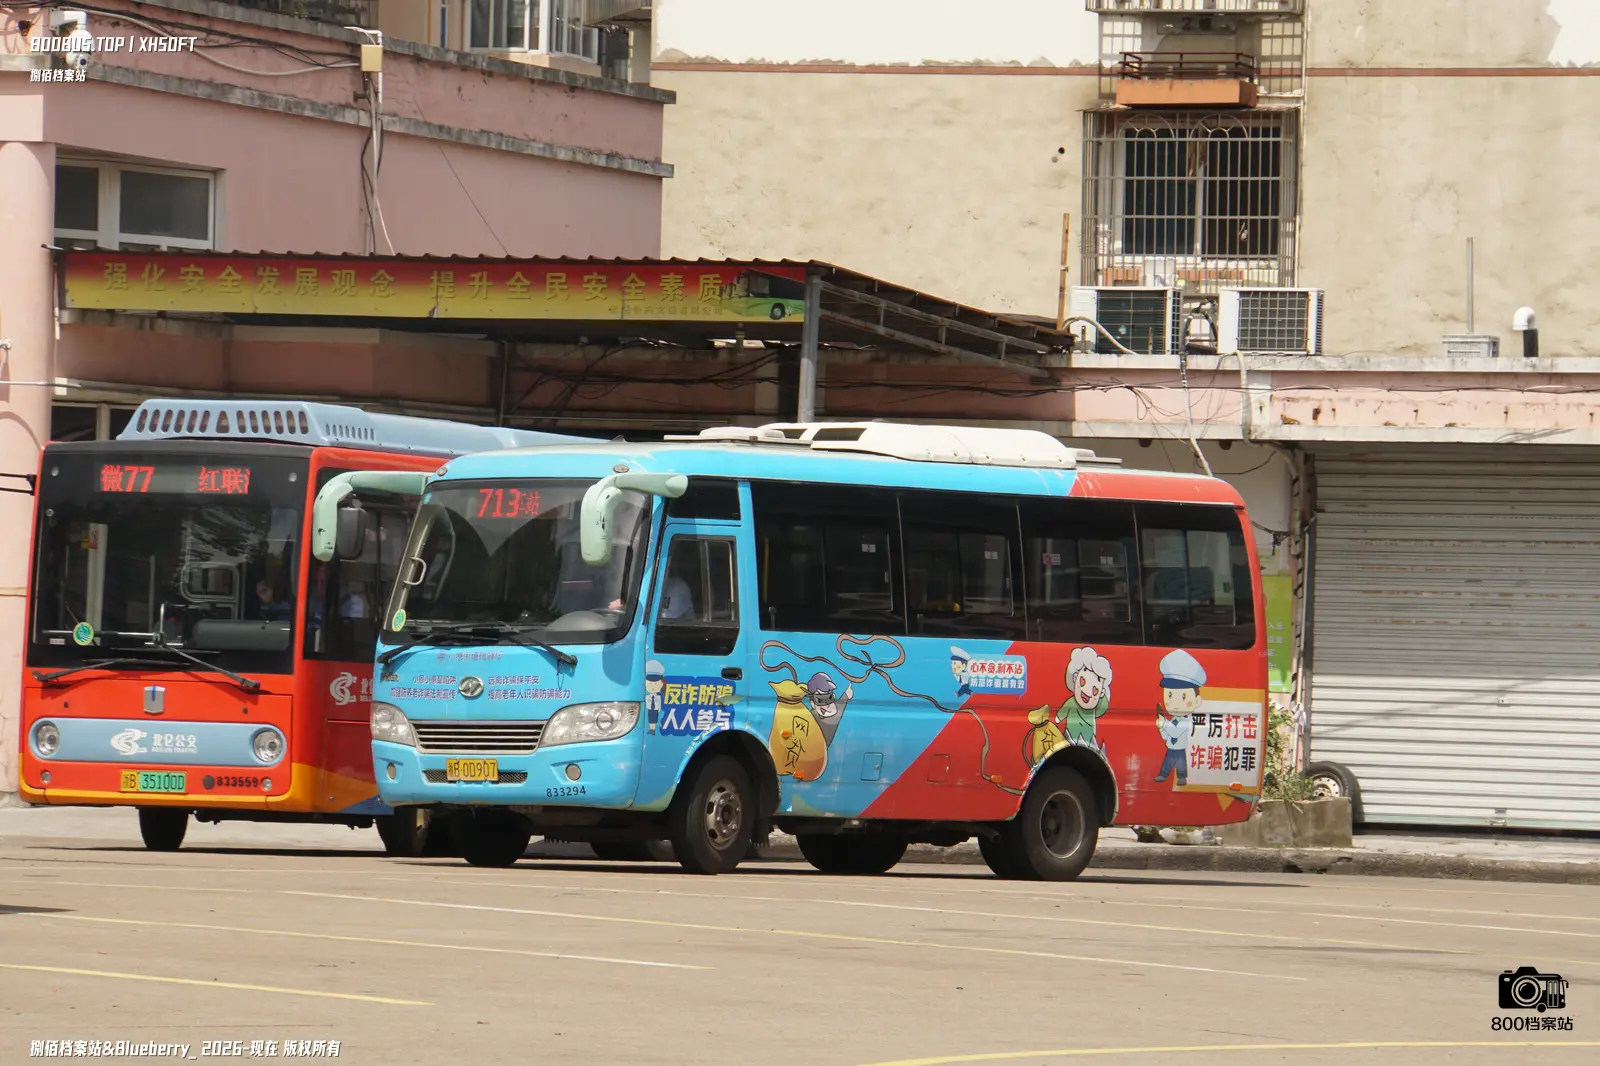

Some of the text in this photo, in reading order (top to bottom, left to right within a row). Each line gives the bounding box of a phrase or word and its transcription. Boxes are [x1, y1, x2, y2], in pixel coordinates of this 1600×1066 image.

[104, 262, 723, 303] 强化安全发展观念 提升全民安全素质
[101, 464, 154, 493] 微77
[477, 488, 521, 517] 713
[664, 683, 734, 706] 反诈防骗
[662, 708, 732, 731] 人人参与
[1190, 713, 1258, 739] 严厉打击
[1190, 744, 1257, 771] 诈骗犯罪
[216, 775, 259, 788] 833559
[546, 785, 587, 798] 833294
